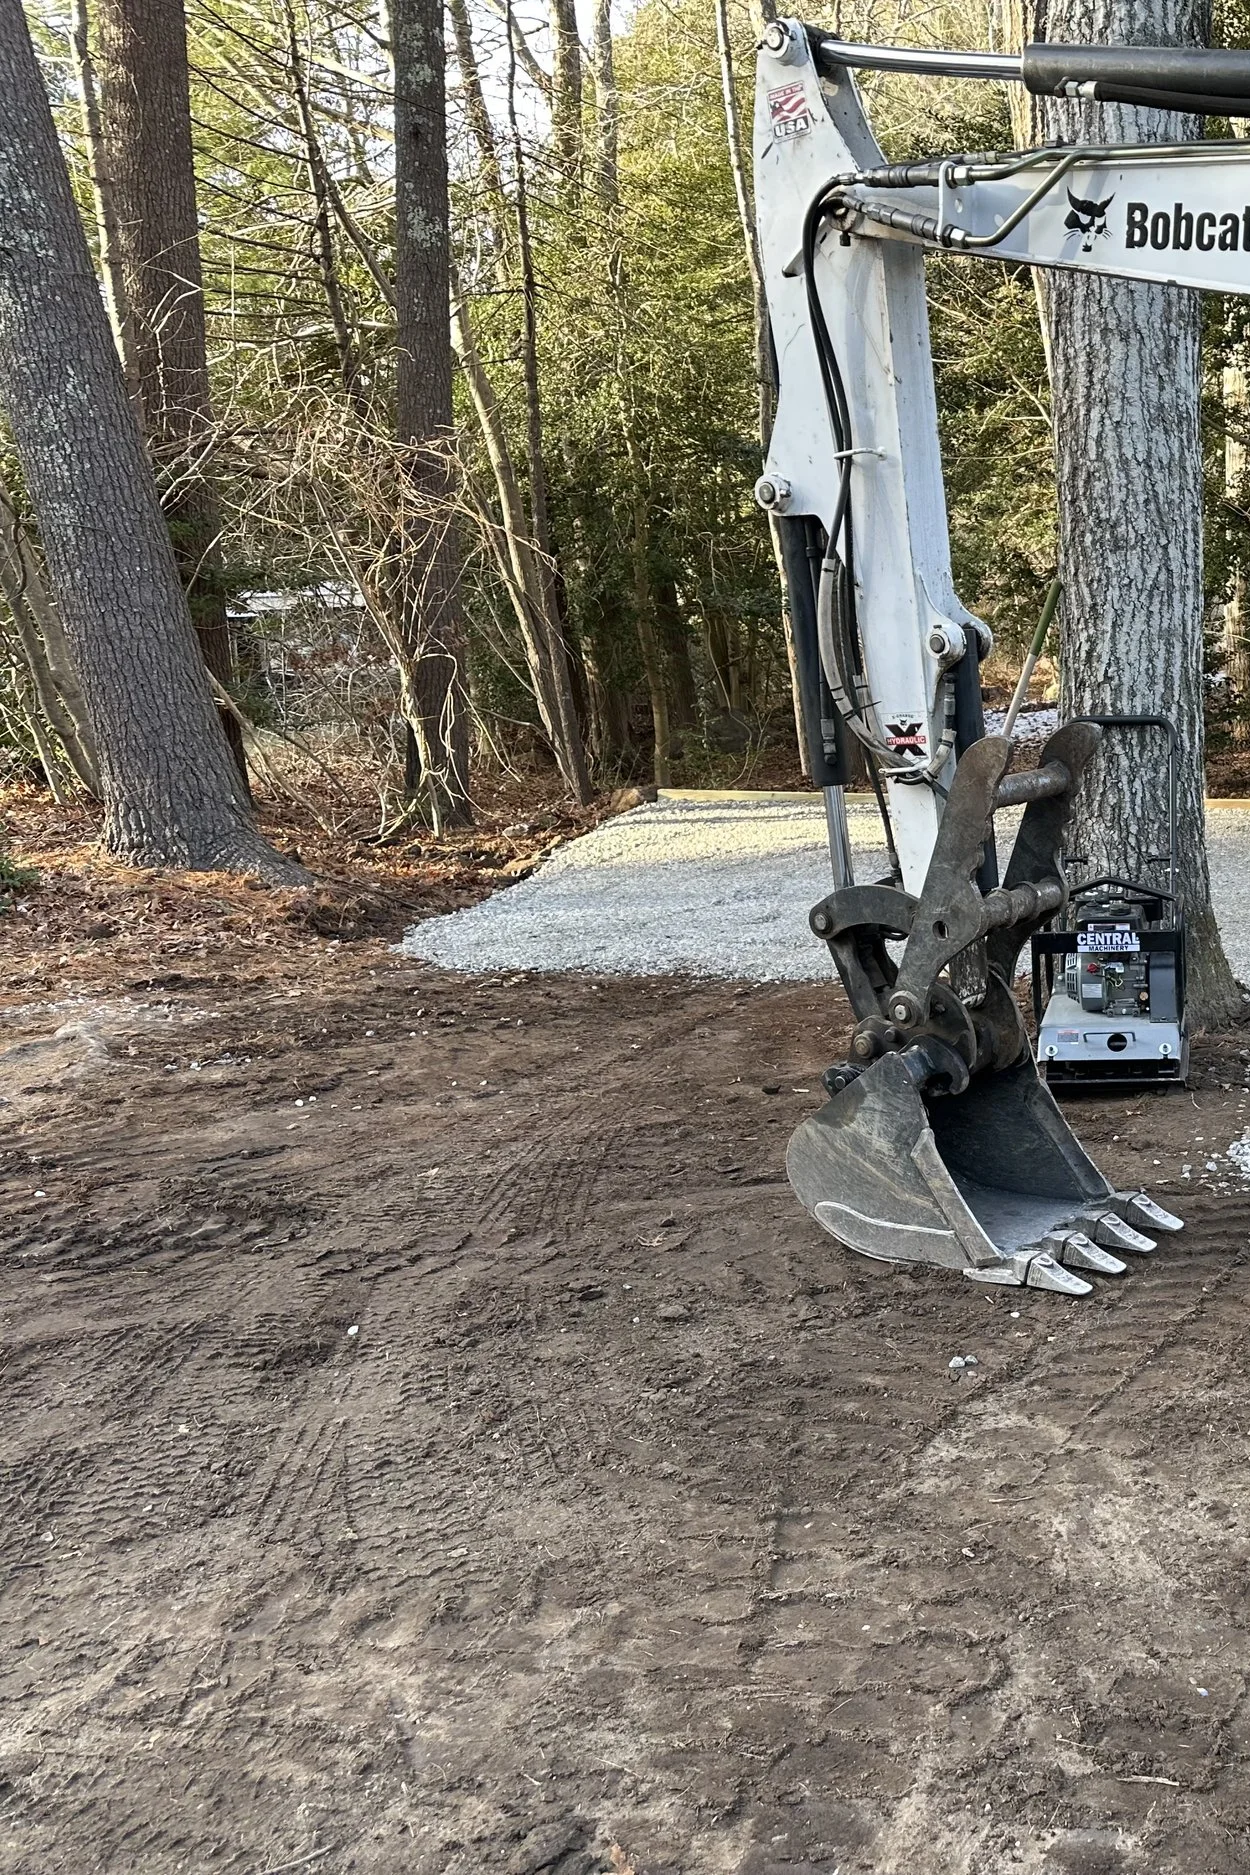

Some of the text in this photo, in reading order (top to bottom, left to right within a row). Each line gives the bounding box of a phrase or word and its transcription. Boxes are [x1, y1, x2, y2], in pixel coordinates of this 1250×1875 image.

[775, 118, 808, 136] USA
[887, 736, 925, 744] HYDRAULIC
[1076, 932, 1140, 945] CENTRAL
